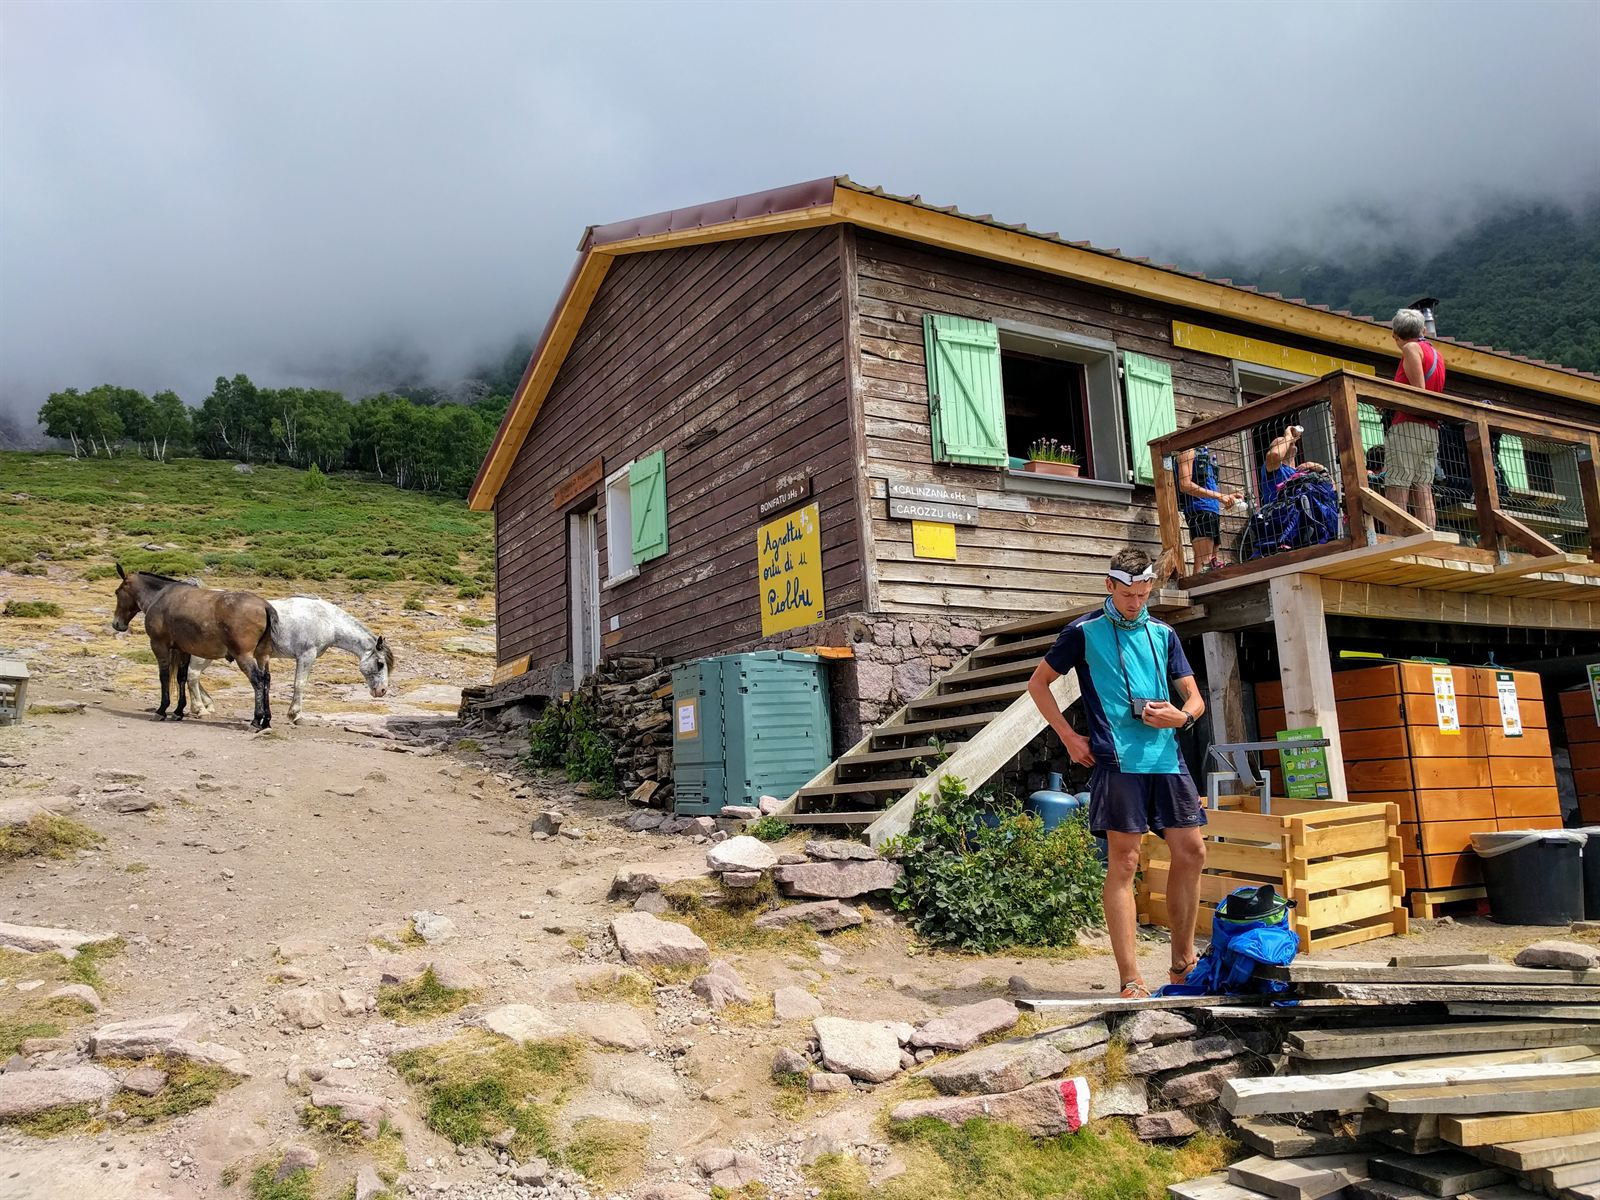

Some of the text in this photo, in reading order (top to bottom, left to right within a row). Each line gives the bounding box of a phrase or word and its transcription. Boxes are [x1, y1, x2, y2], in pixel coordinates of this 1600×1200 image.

[760, 493, 787, 513] BONIFATU
[896, 504, 944, 518] CAROZZU
[763, 551, 808, 581] ortu di u
